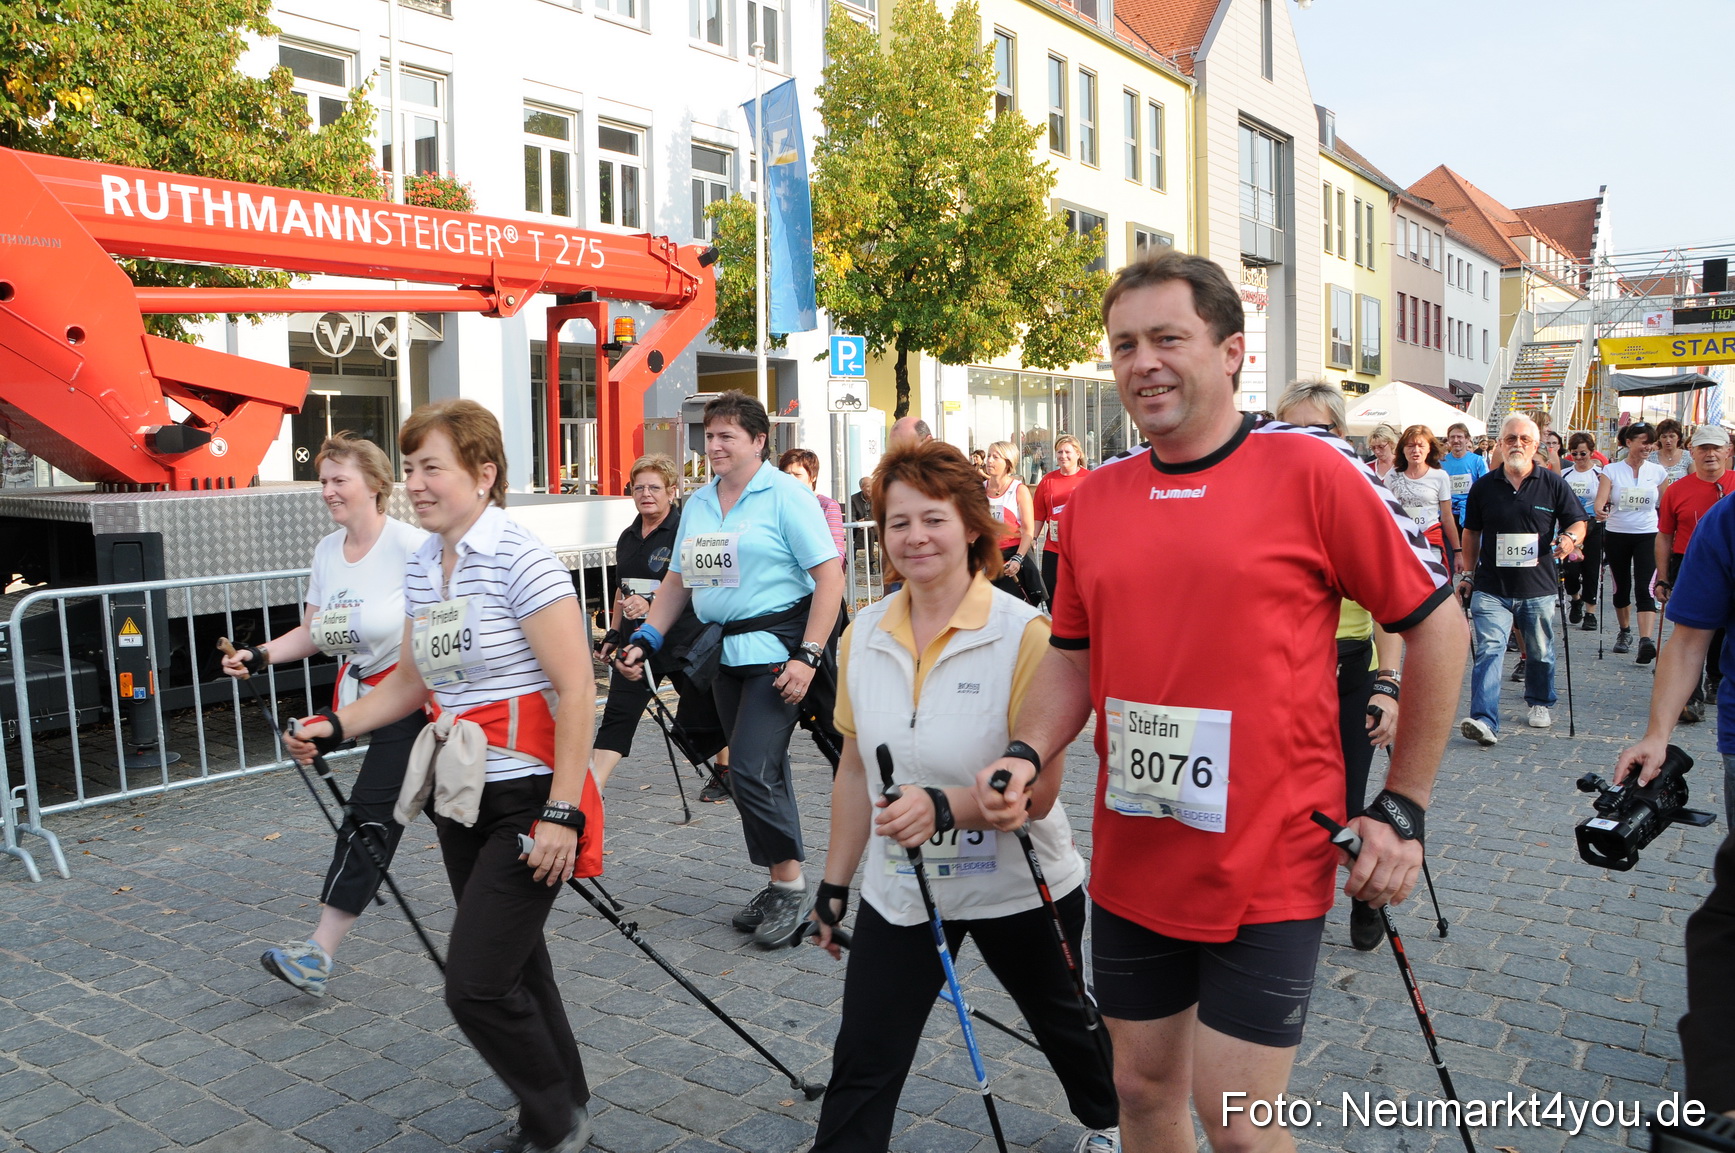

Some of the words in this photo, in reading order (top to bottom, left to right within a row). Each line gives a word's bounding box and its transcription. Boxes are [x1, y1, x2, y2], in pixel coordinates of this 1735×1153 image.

[527, 230, 545, 262] T
[554, 234, 605, 269] 275
[1241, 261, 1269, 289] ltstadt
[1241, 289, 1269, 310] assage
[838, 341, 857, 371] P
[1149, 485, 1207, 500] hummel
[1628, 496, 1651, 504] 8106
[695, 537, 730, 547] Marianne
[1507, 546, 1534, 556] 8154
[695, 553, 733, 569] 8048
[323, 611, 347, 625] Andrea
[325, 629, 361, 645] 8050
[431, 628, 472, 658] 8049
[1129, 711, 1179, 738] Stefan
[1130, 748, 1213, 788] 8076
[543, 809, 570, 819] LEKI
